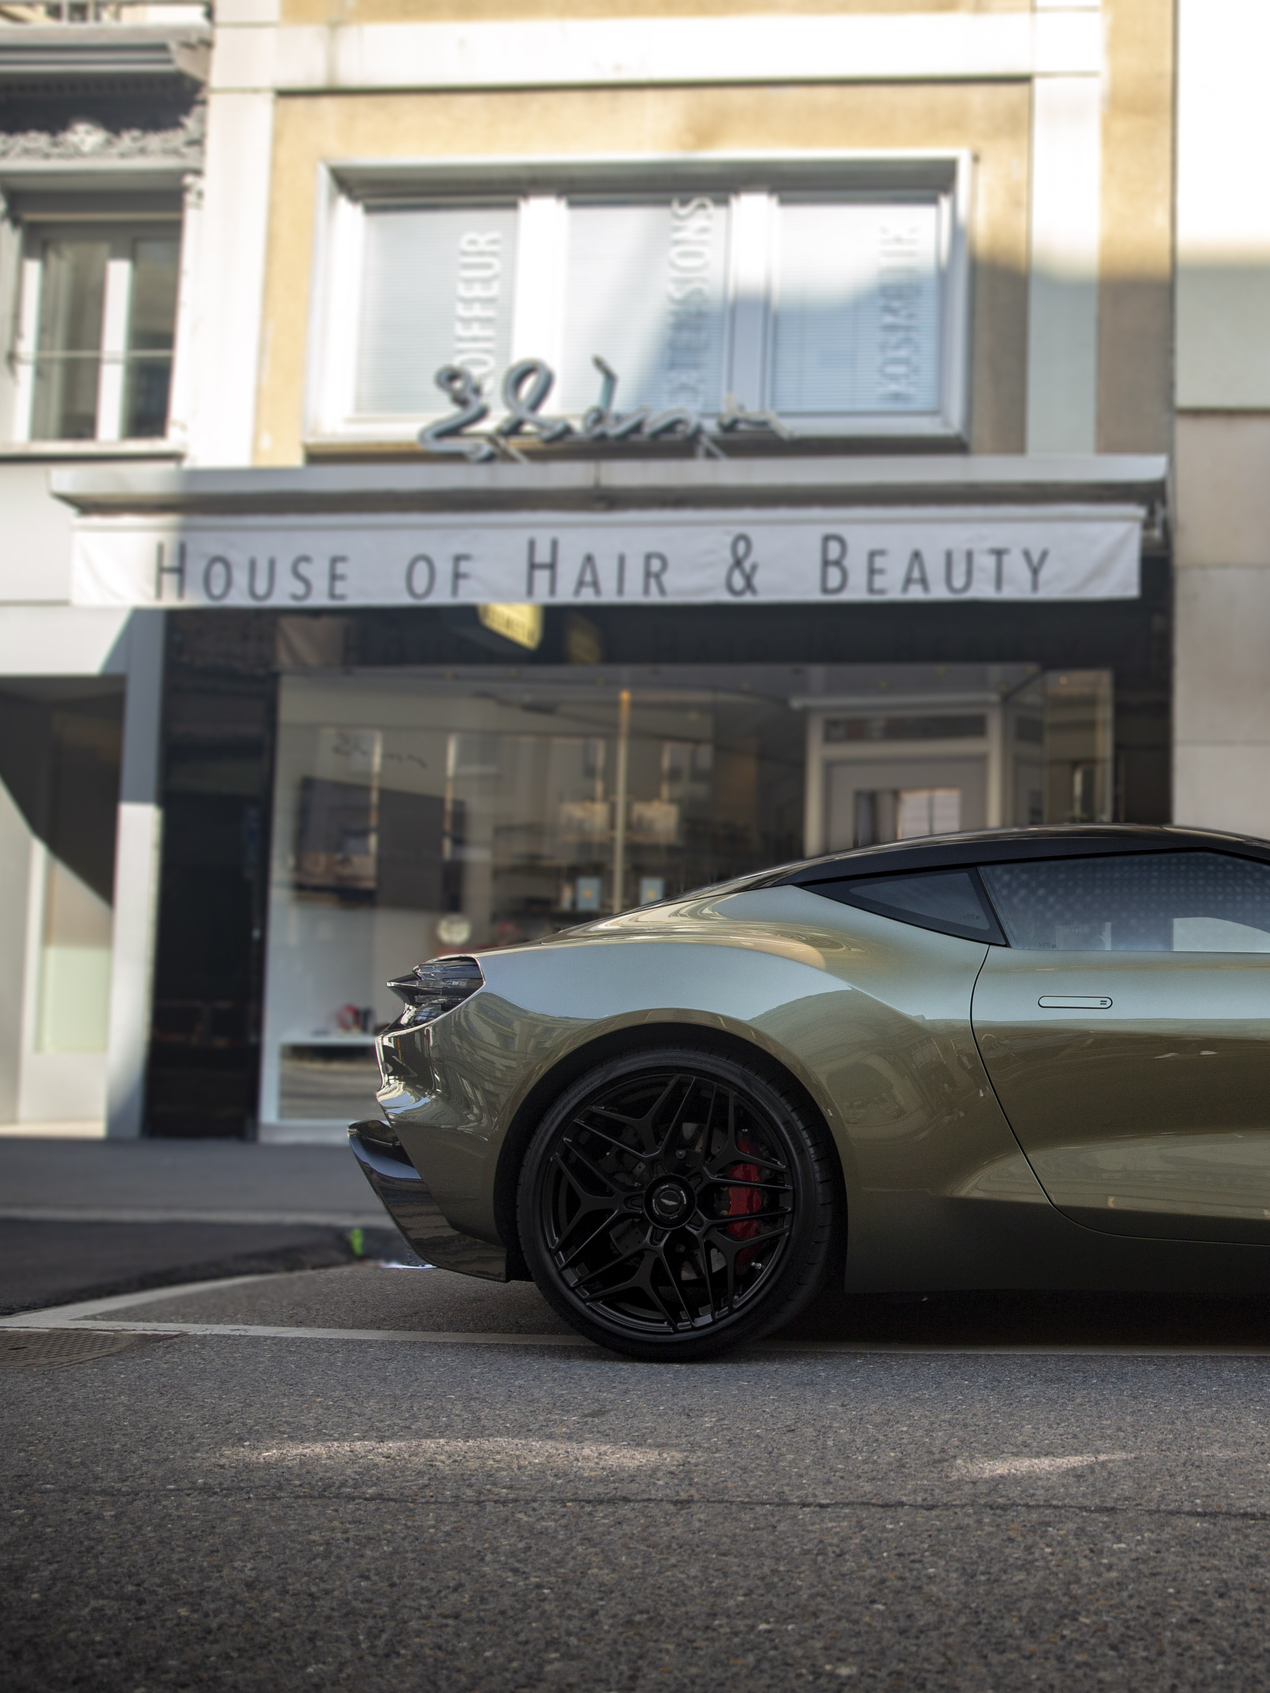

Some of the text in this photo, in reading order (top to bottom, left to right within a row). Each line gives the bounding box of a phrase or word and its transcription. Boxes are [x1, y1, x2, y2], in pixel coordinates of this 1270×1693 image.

[155, 532, 1050, 602] HOUSE OF HAIR & BEAUTY
